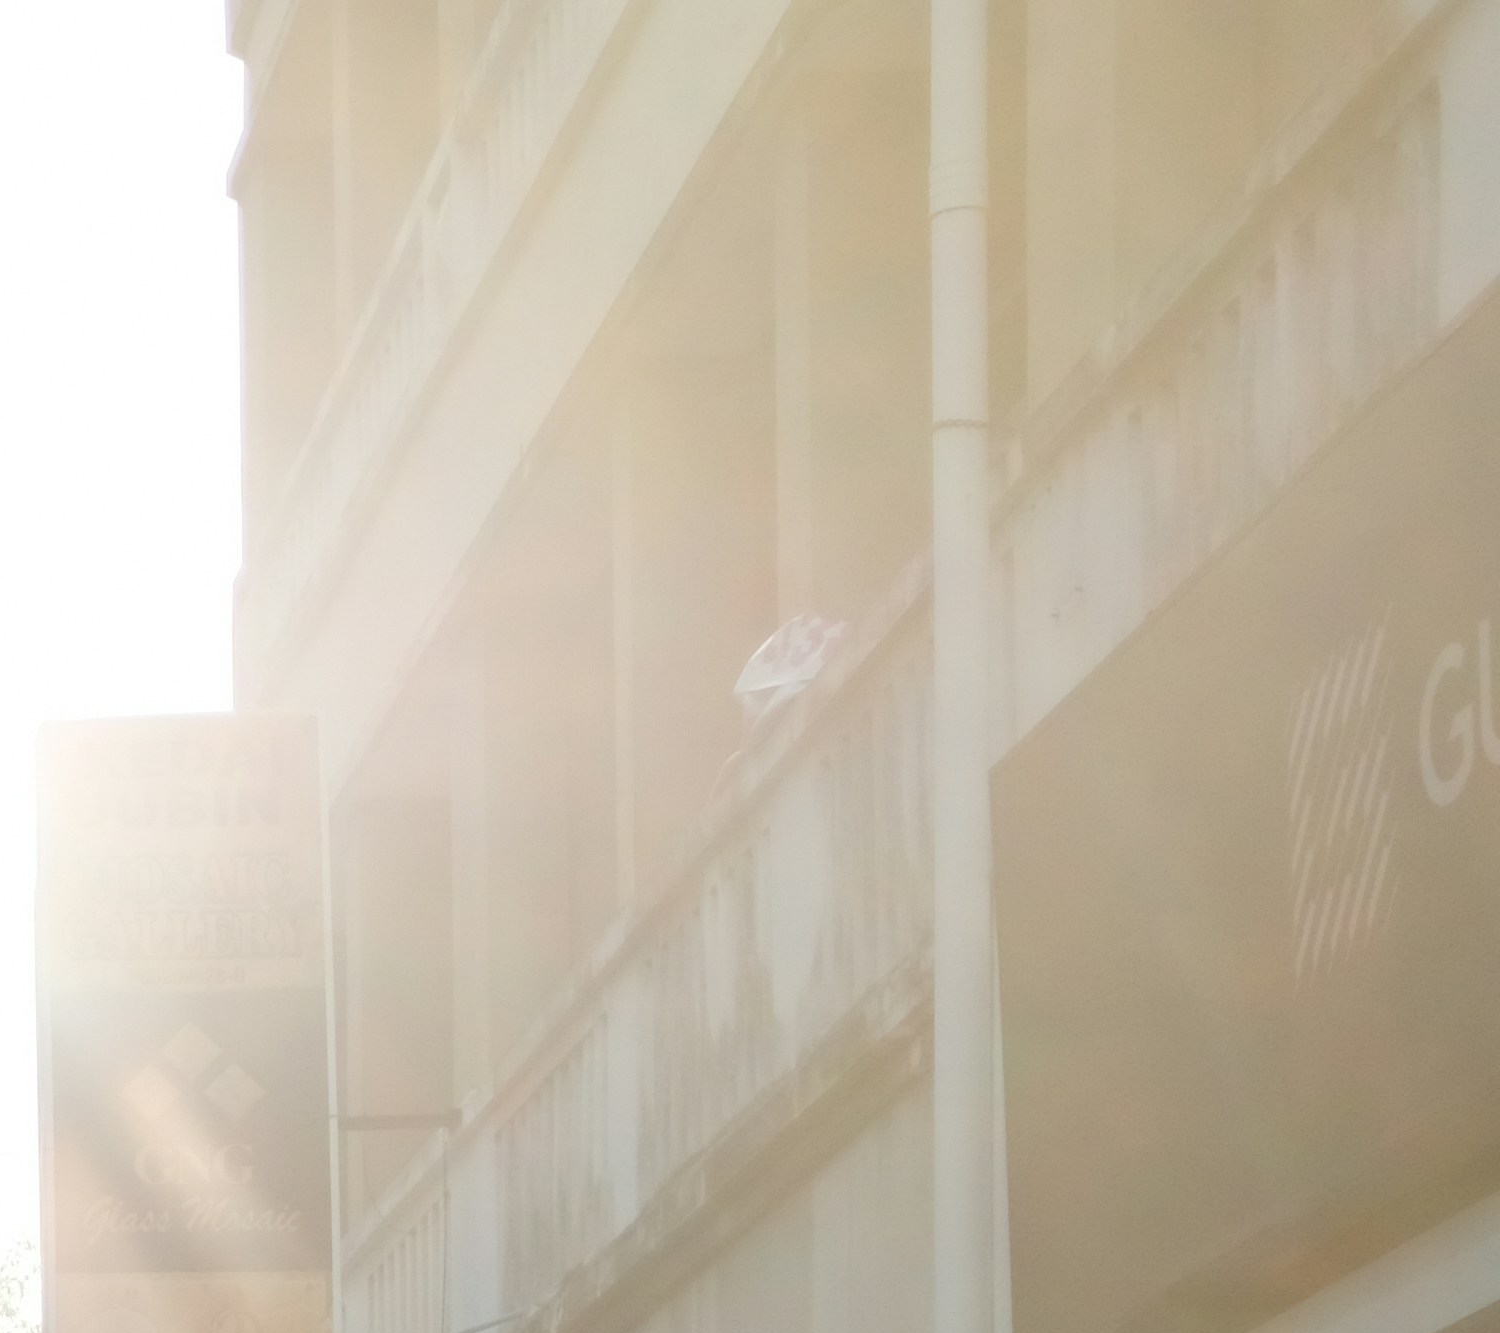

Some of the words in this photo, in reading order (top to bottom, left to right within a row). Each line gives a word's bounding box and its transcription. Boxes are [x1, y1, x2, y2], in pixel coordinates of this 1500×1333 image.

[134, 1144, 257, 1185] GNG
[83, 1196, 171, 1248] Glass
[181, 1195, 301, 1233] Mosaic
